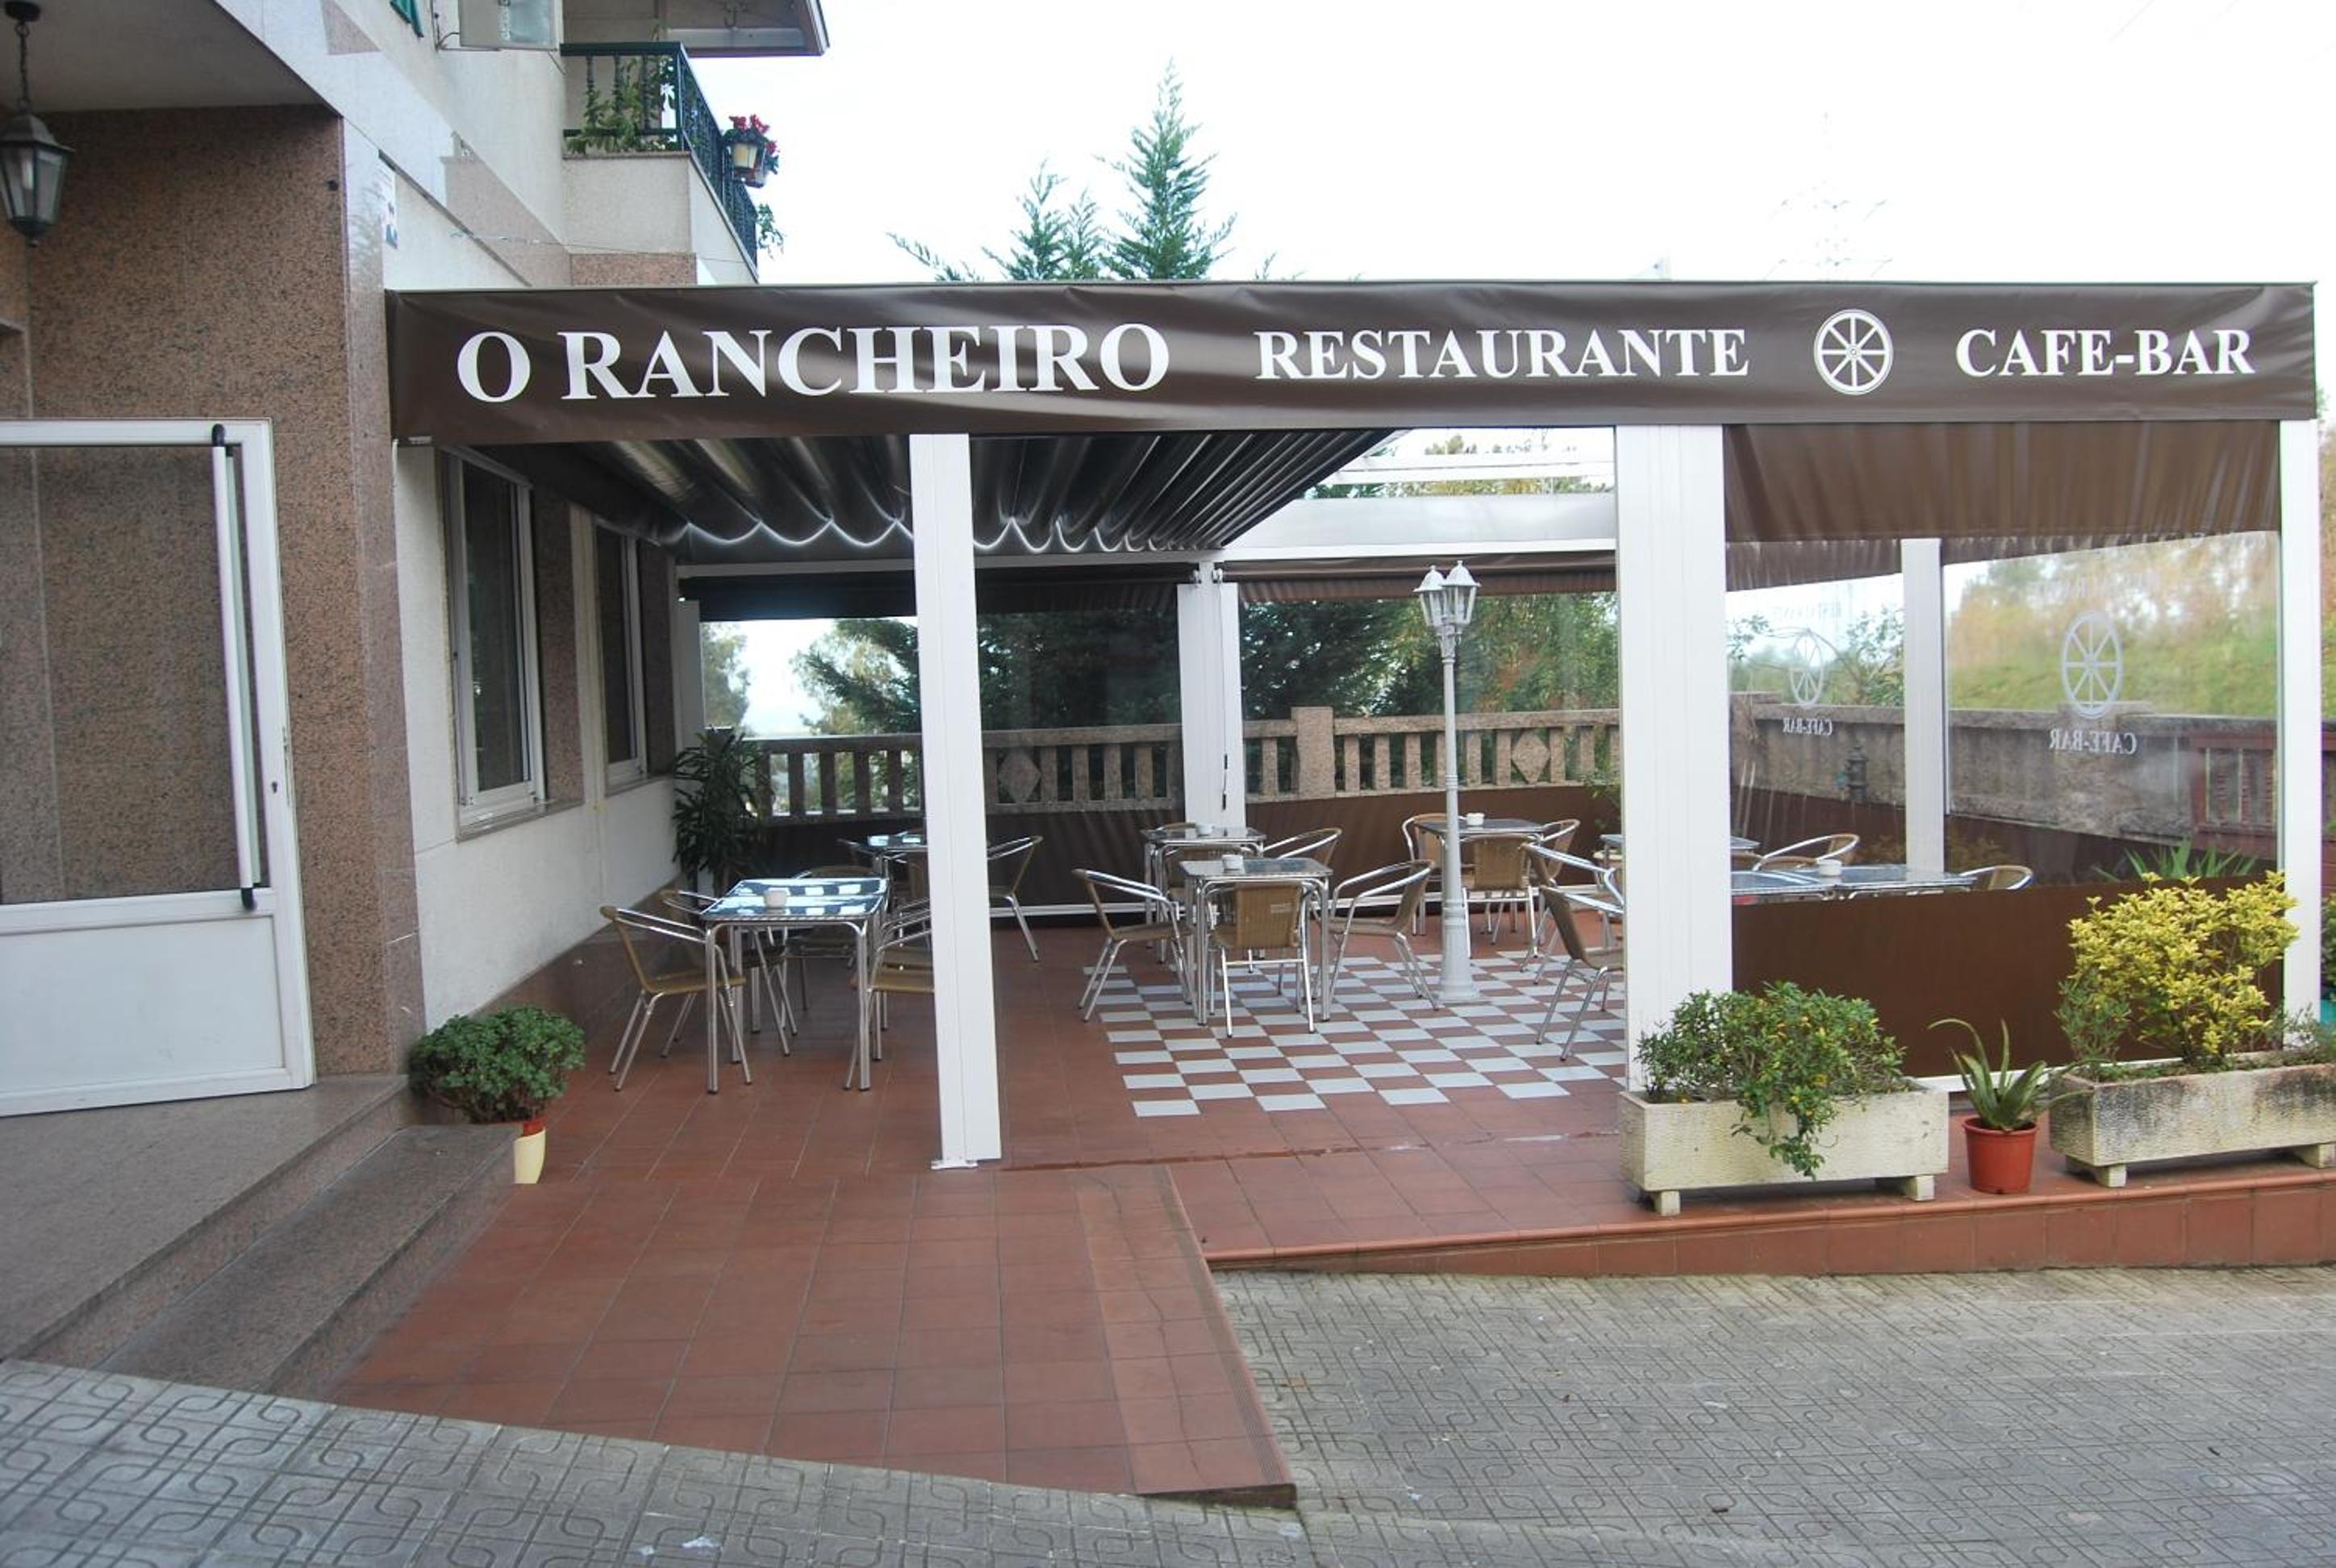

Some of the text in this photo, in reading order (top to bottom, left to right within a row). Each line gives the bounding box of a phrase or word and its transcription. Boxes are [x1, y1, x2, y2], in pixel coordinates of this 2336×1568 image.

[457, 323, 2256, 402] O RANCHEIRO RESTAURANTE CAFE-BAR
